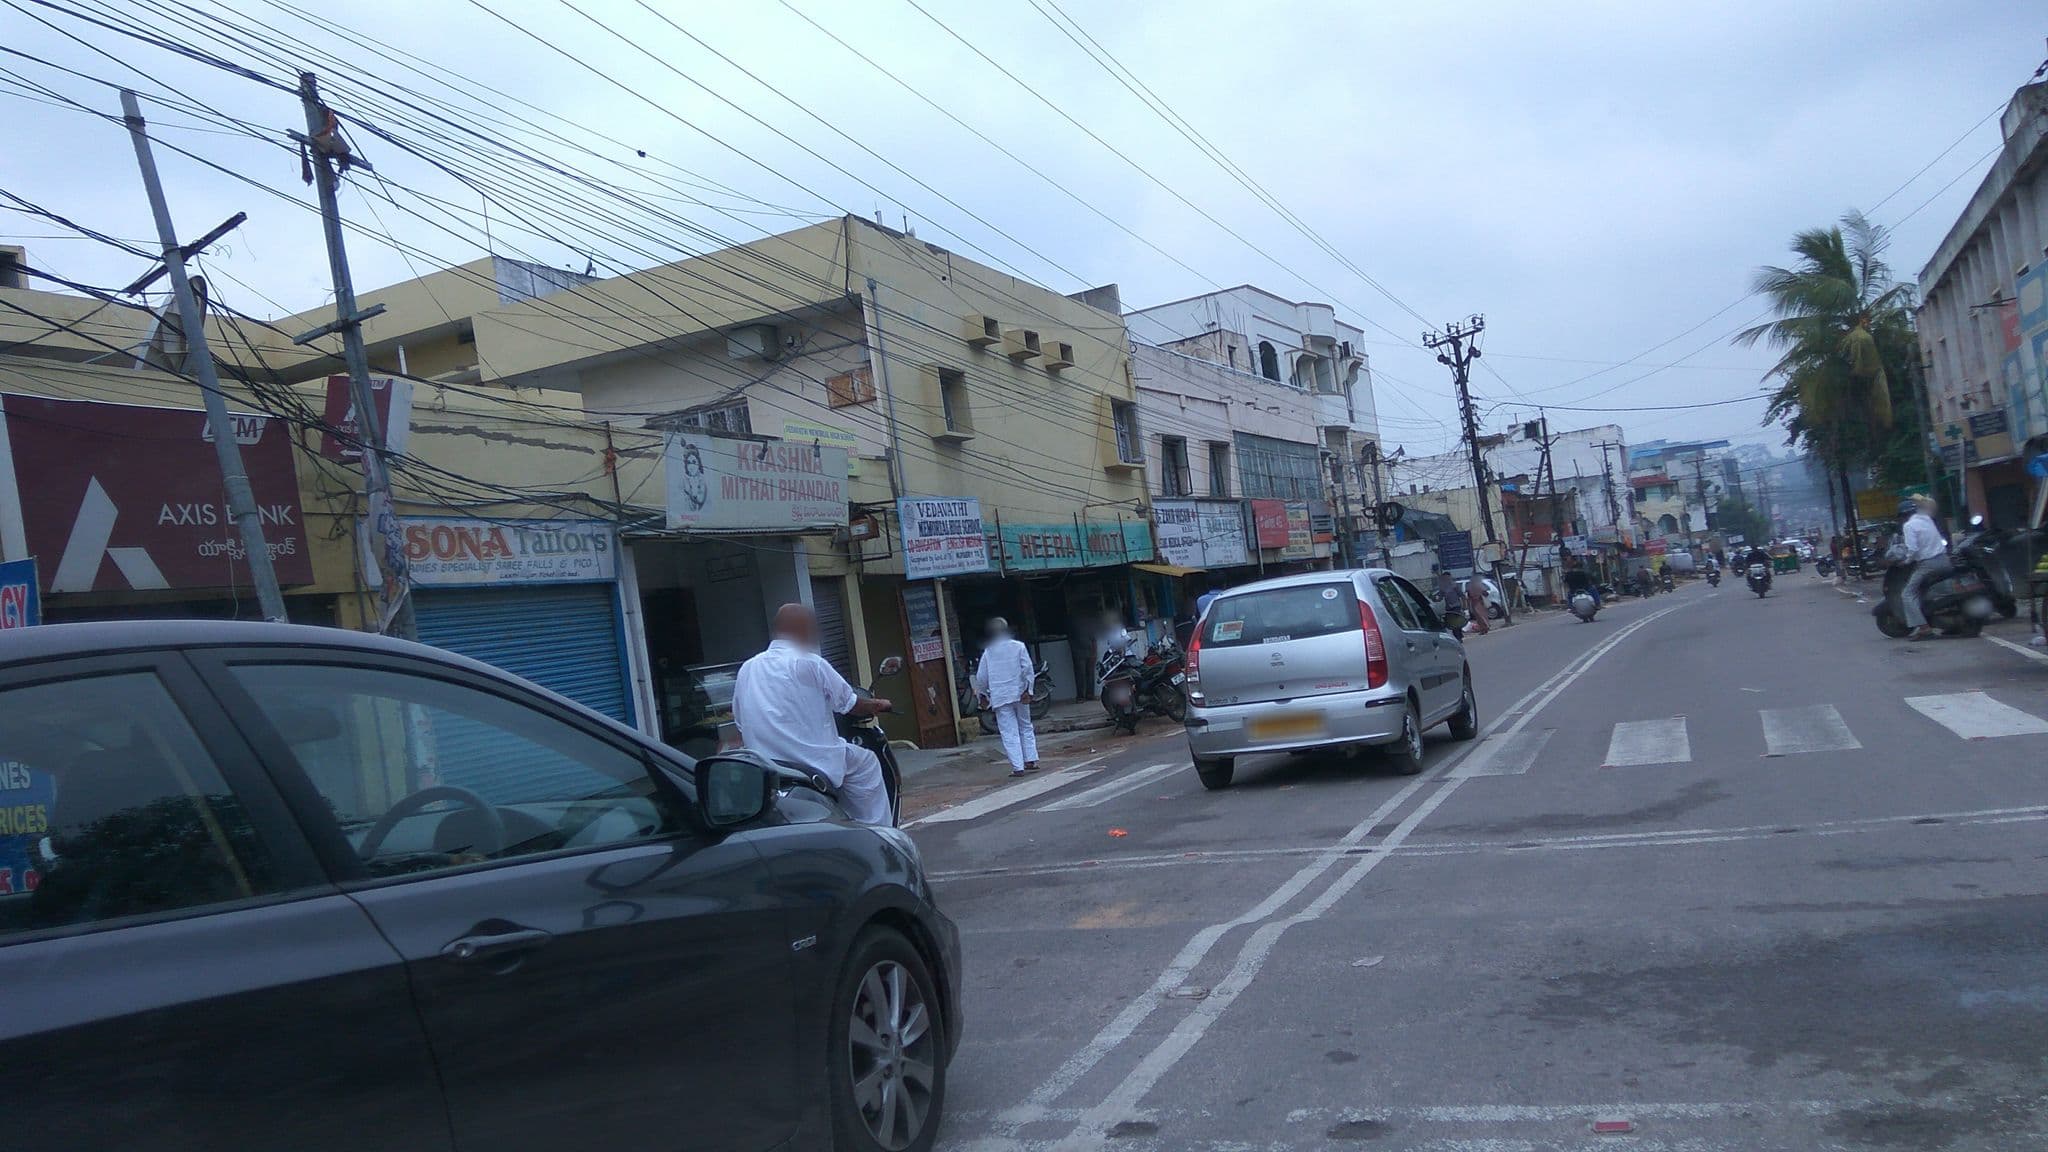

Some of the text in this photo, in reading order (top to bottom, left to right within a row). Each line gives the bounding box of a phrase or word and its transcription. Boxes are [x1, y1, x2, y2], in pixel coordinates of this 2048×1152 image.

[737, 443, 824, 474] KRASHNA
[721, 476, 840, 502] MITHAI BHANDAR
[158, 503, 296, 526] AXIS BNK
[916, 502, 968, 518] VEDAVATHI
[405, 525, 513, 561] SONA
[513, 528, 608, 555] Tailors
[1018, 532, 1077, 560] HEERA
[408, 563, 438, 574] ADIES
